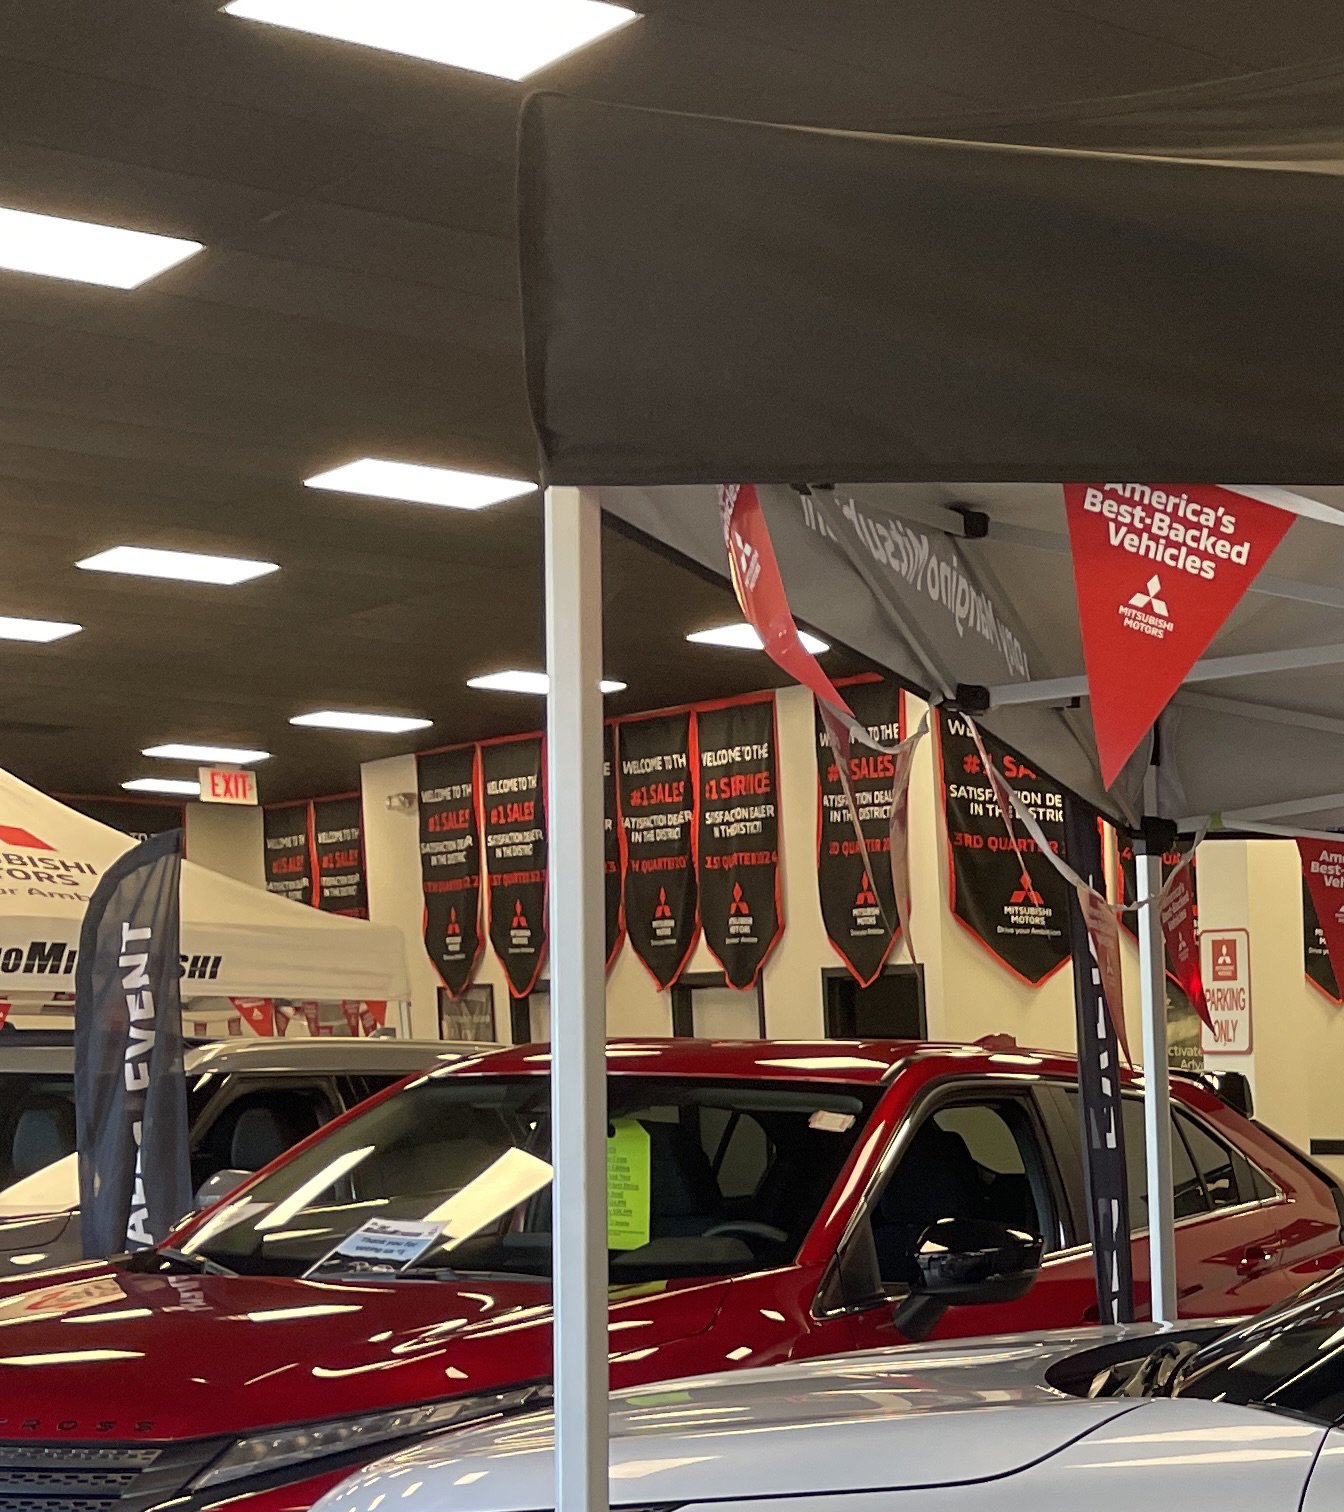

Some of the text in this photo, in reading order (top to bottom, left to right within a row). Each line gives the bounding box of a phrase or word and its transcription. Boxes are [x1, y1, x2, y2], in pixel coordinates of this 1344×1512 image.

[1104, 483, 1236, 535] America's
[1083, 487, 1250, 566] Best-Backed
[1108, 522, 1216, 580] Vehicles
[1118, 605, 1174, 632] MITSUBISHI
[1124, 617, 1164, 639] MOTORS
[851, 755, 894, 781] SALES
[210, 772, 248, 800] EXIT
[0, 852, 98, 876] BISHI
[118, 921, 155, 1092] EVENT
[1205, 988, 1246, 1012] PARKING
[1214, 1019, 1239, 1044] ONLY
